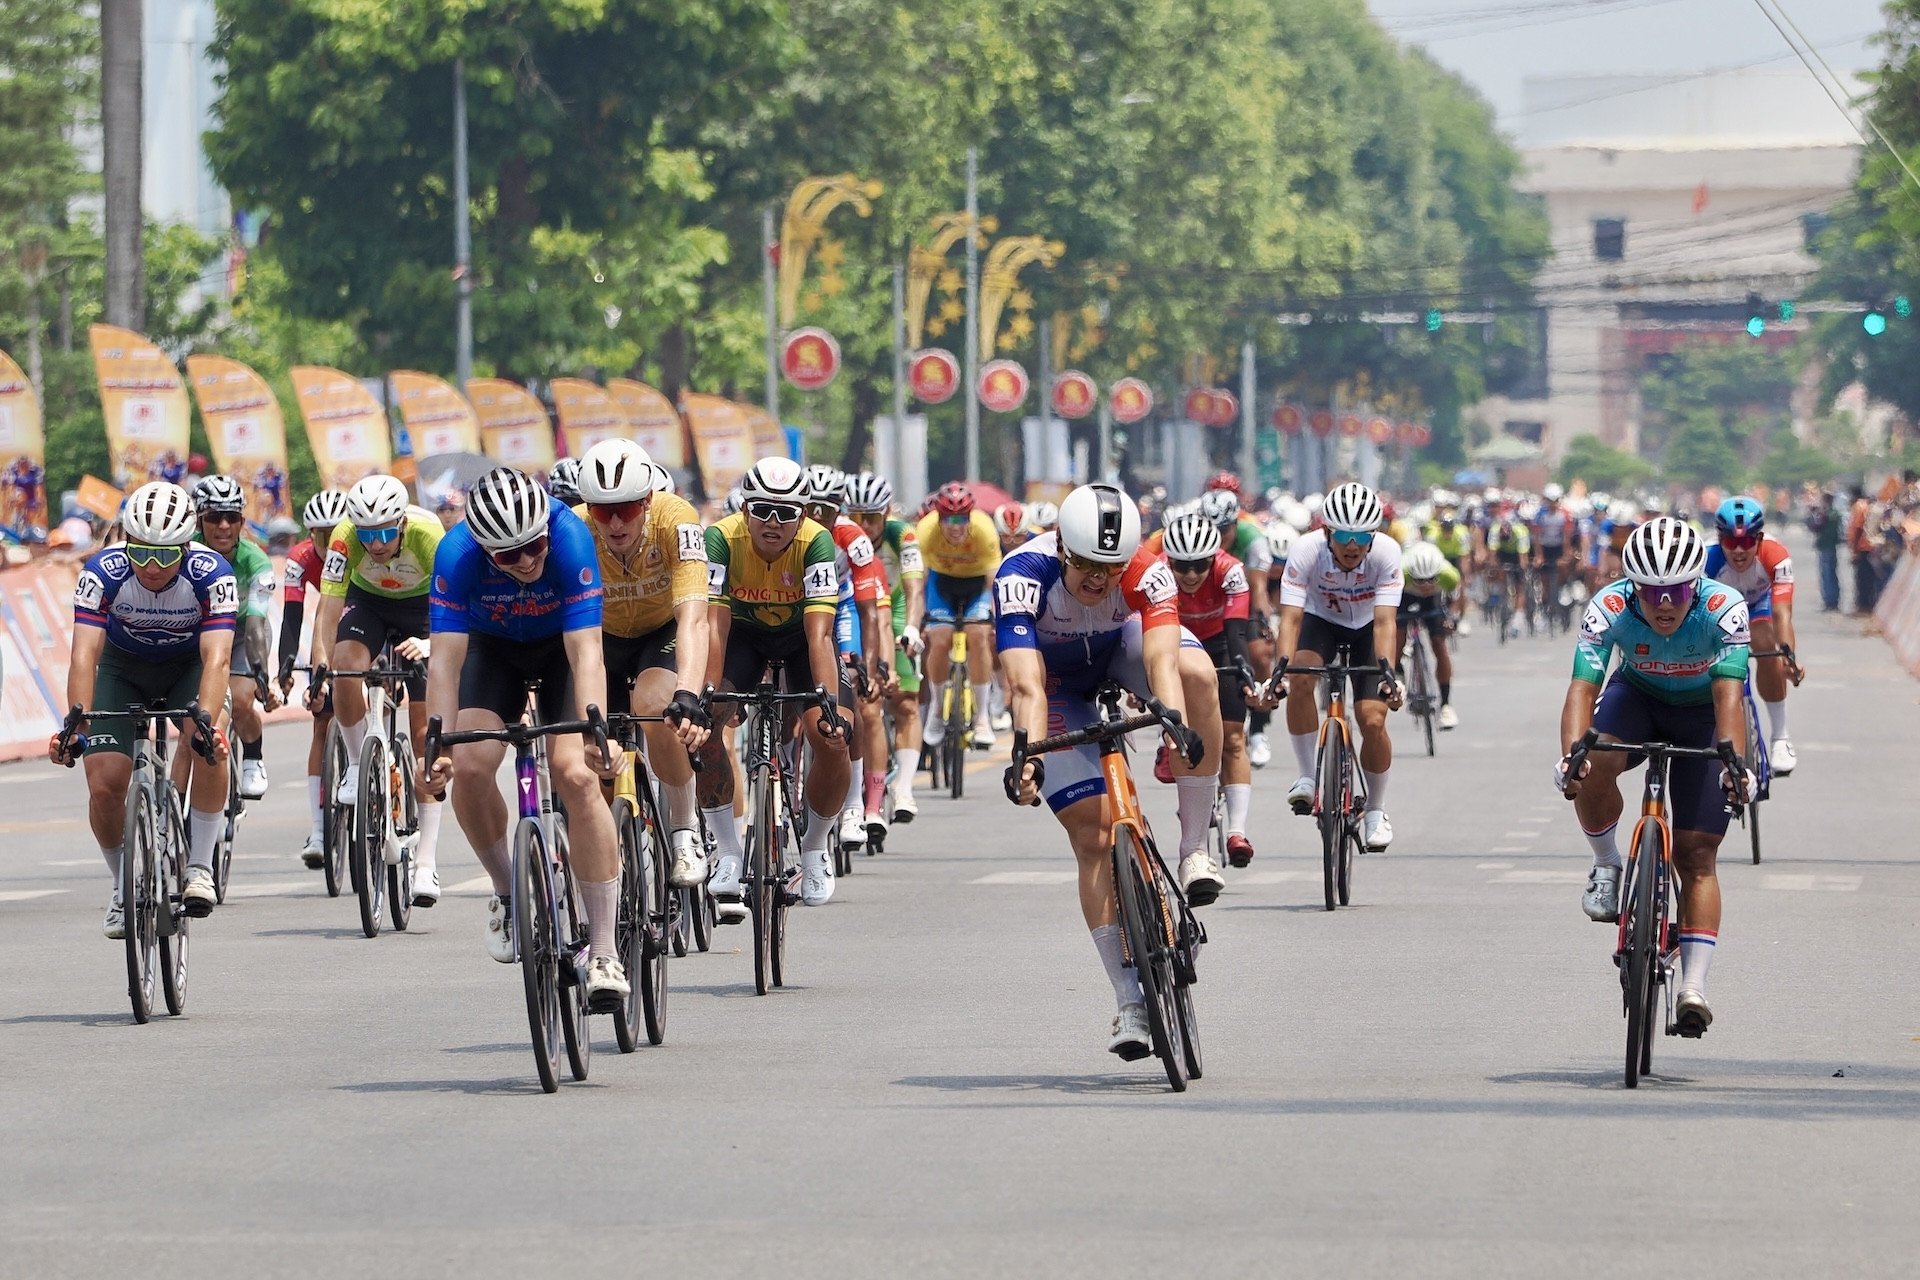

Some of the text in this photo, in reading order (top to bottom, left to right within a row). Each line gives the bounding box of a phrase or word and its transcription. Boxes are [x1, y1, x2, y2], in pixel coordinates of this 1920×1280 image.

[326, 556, 344, 574] 47
[75, 576, 97, 598] 97
[811, 568, 831, 588] 41
[216, 582, 234, 603] 97
[1003, 582, 1038, 604] 107
[1109, 764, 1126, 816] ORBEA
